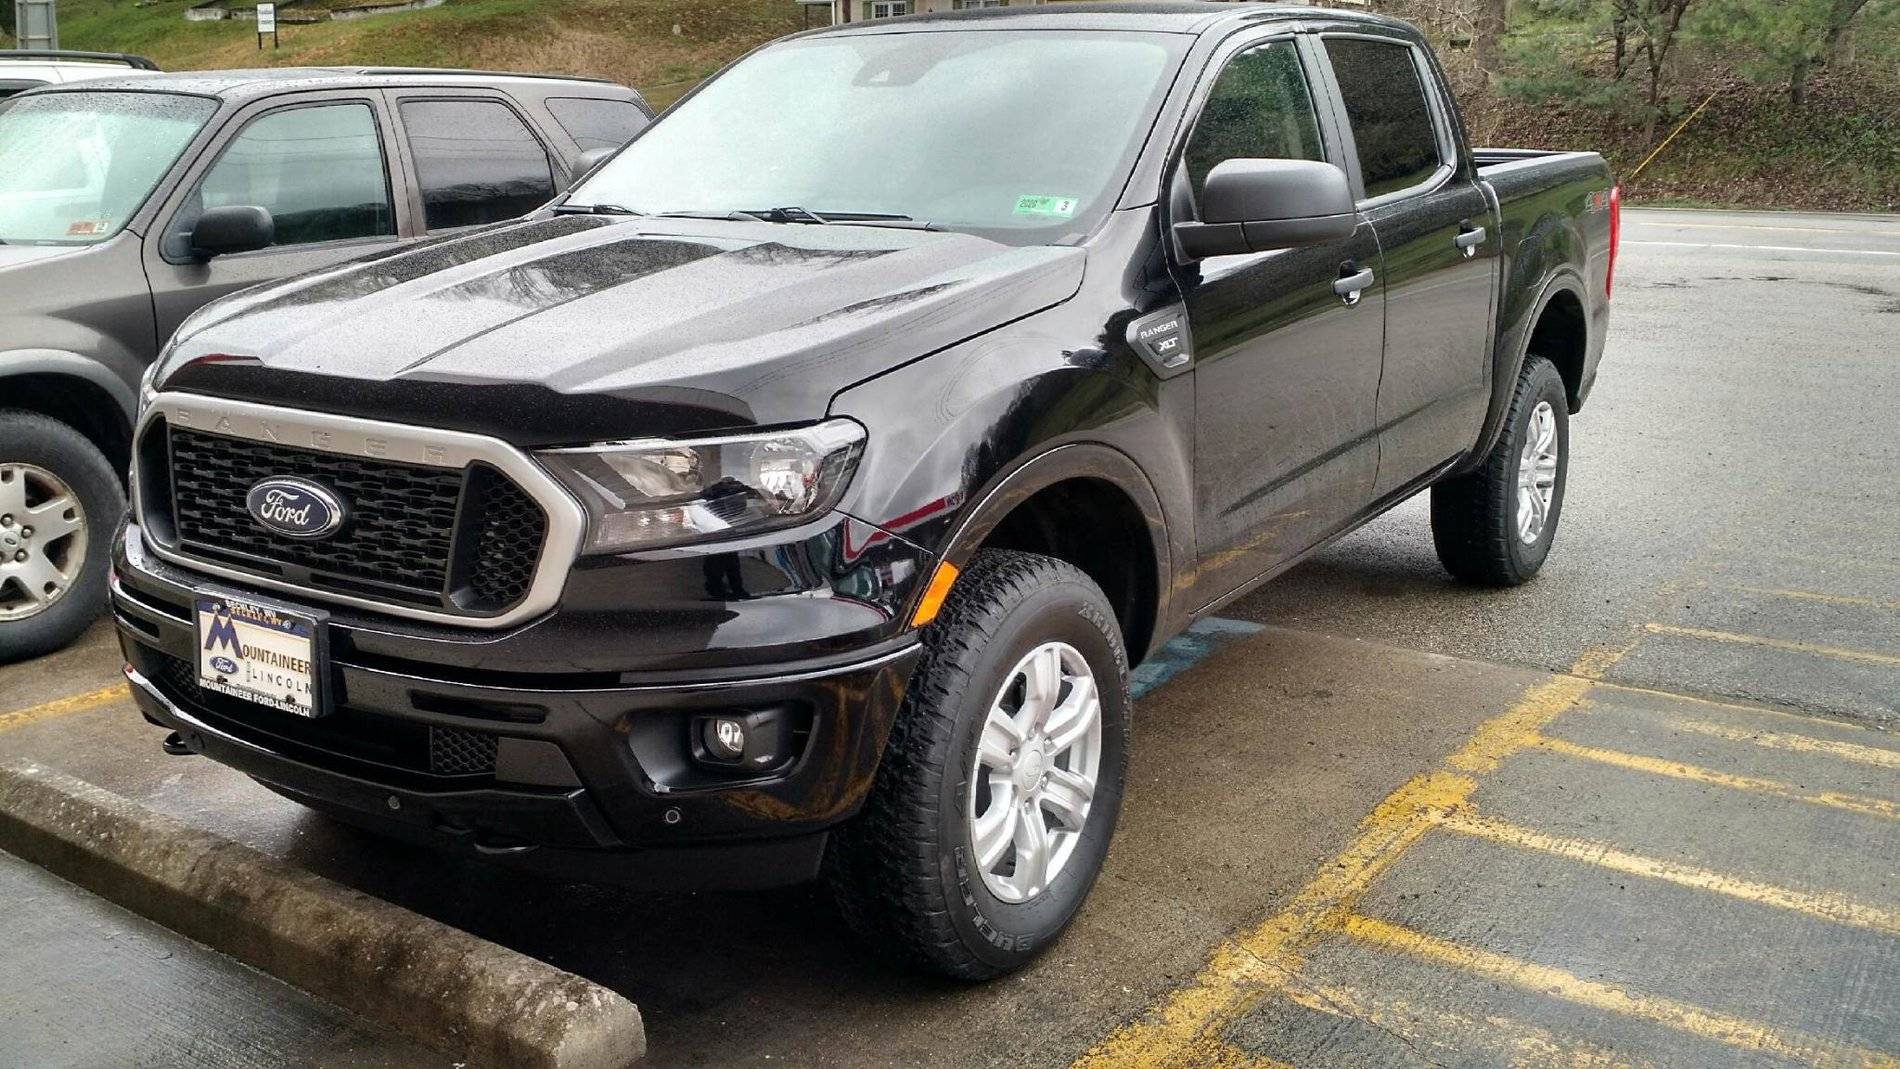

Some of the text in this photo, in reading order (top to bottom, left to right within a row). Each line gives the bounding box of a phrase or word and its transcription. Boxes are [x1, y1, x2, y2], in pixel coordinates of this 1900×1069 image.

[1140, 320, 1178, 339] RANGER
[1158, 337, 1178, 352] XLT
[175, 407, 446, 464] RANGER
[260, 489, 310, 527] Ford
[204, 614, 311, 675] MOUNTAINEER
[214, 658, 234, 673] Ford
[252, 668, 311, 694] LINCOLN
[200, 678, 252, 702] MOUNTAINEER
[253, 693, 310, 717] FORD-LINCOLN
